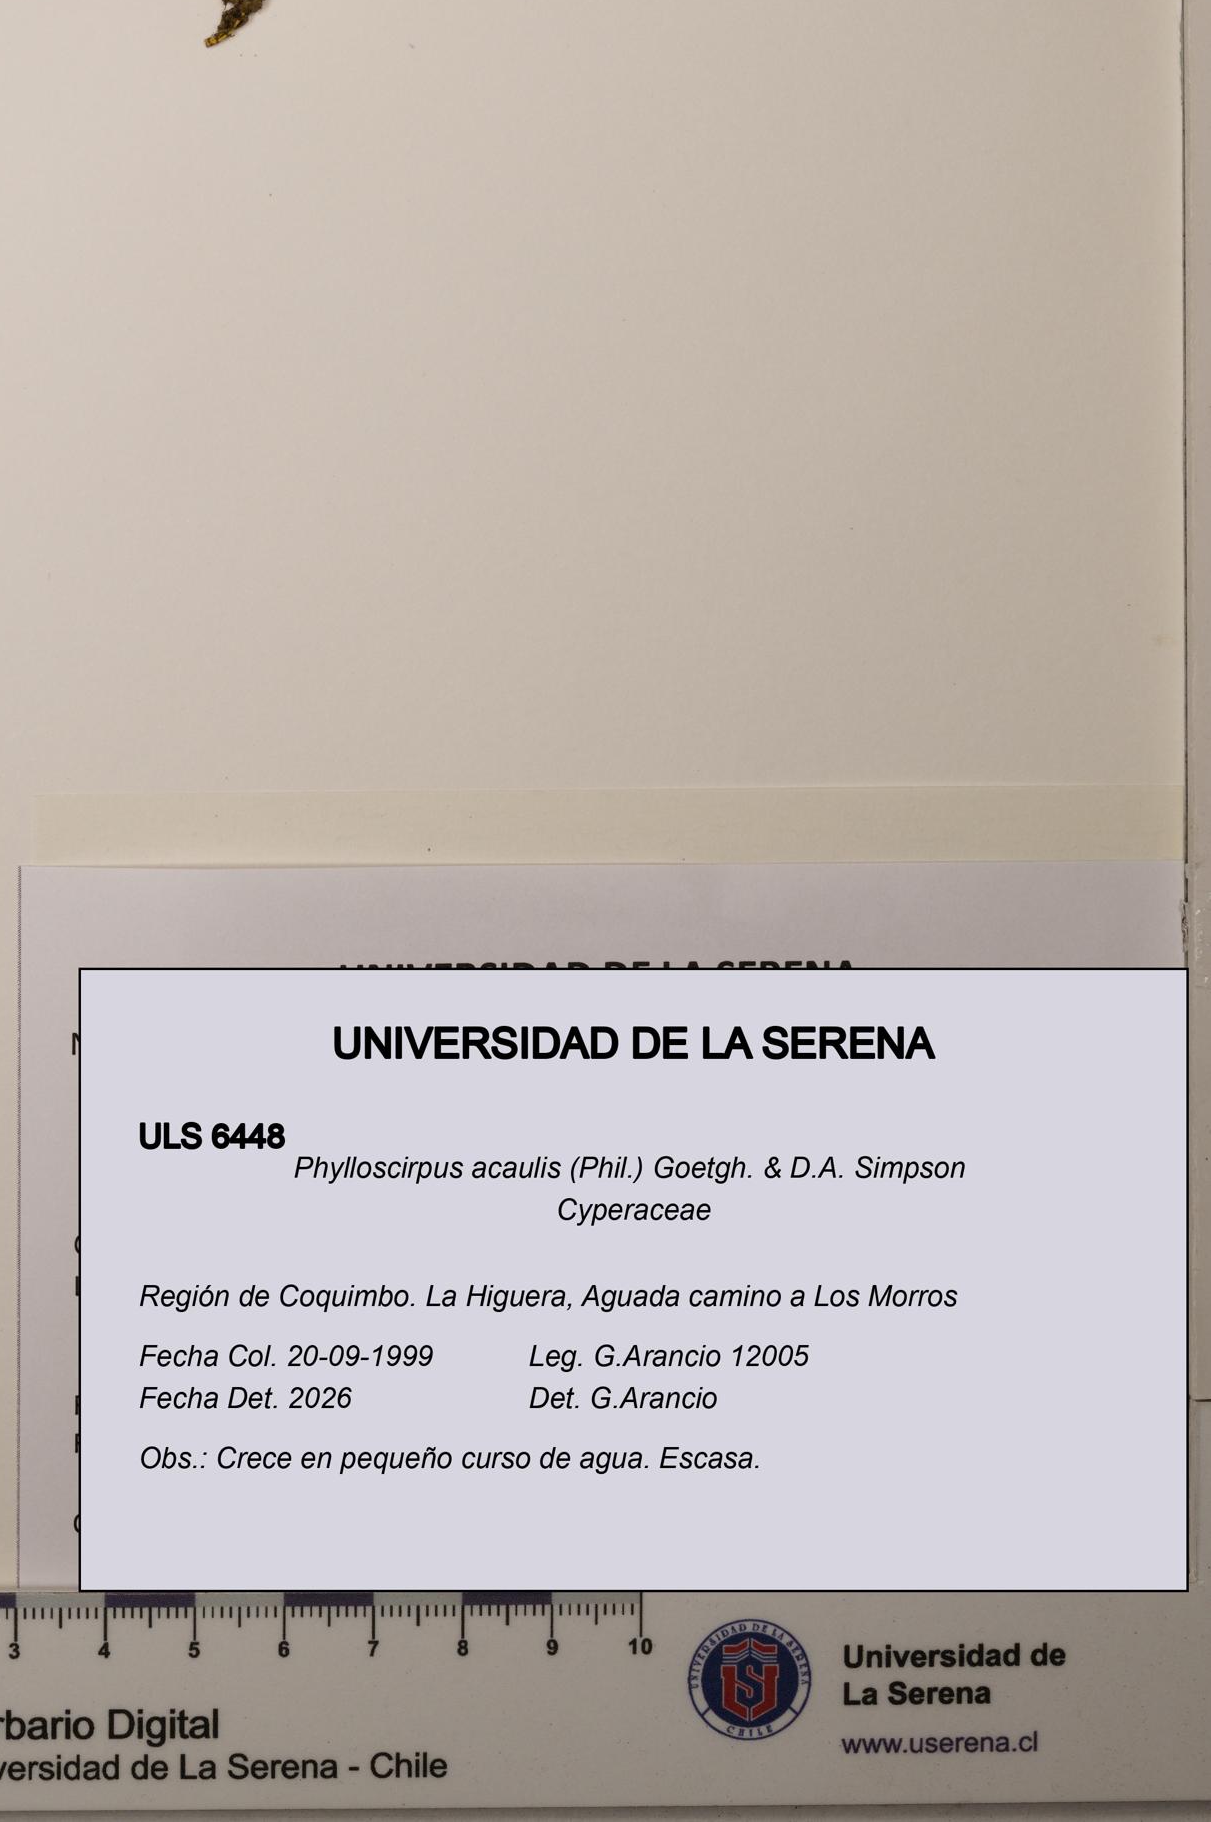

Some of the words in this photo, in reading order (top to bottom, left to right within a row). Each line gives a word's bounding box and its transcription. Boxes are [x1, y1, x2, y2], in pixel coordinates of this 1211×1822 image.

[751, 1623, 768, 1632] DE
[771, 1628, 785, 1641] LA
[8, 1641, 21, 1660] 3
[97, 1641, 111, 1660] 4
[187, 1641, 201, 1659] 5
[277, 1639, 291, 1659] 6
[367, 1639, 380, 1658] 7
[456, 1639, 469, 1658] 8
[545, 1639, 560, 1657] 9
[628, 1639, 654, 1656] 10
[843, 1642, 1021, 1669] Universidad
[1029, 1641, 1067, 1667] de
[843, 1681, 878, 1707] La
[887, 1680, 992, 1706] Serena
[107, 1707, 219, 1748] Digital
[726, 1725, 773, 1737] CHILE
[841, 1730, 1038, 1755] www.userena.cl
[130, 1753, 169, 1781] de
[179, 1753, 217, 1781] La
[227, 1752, 338, 1781] Serena
[369, 1751, 448, 1779] Chile
